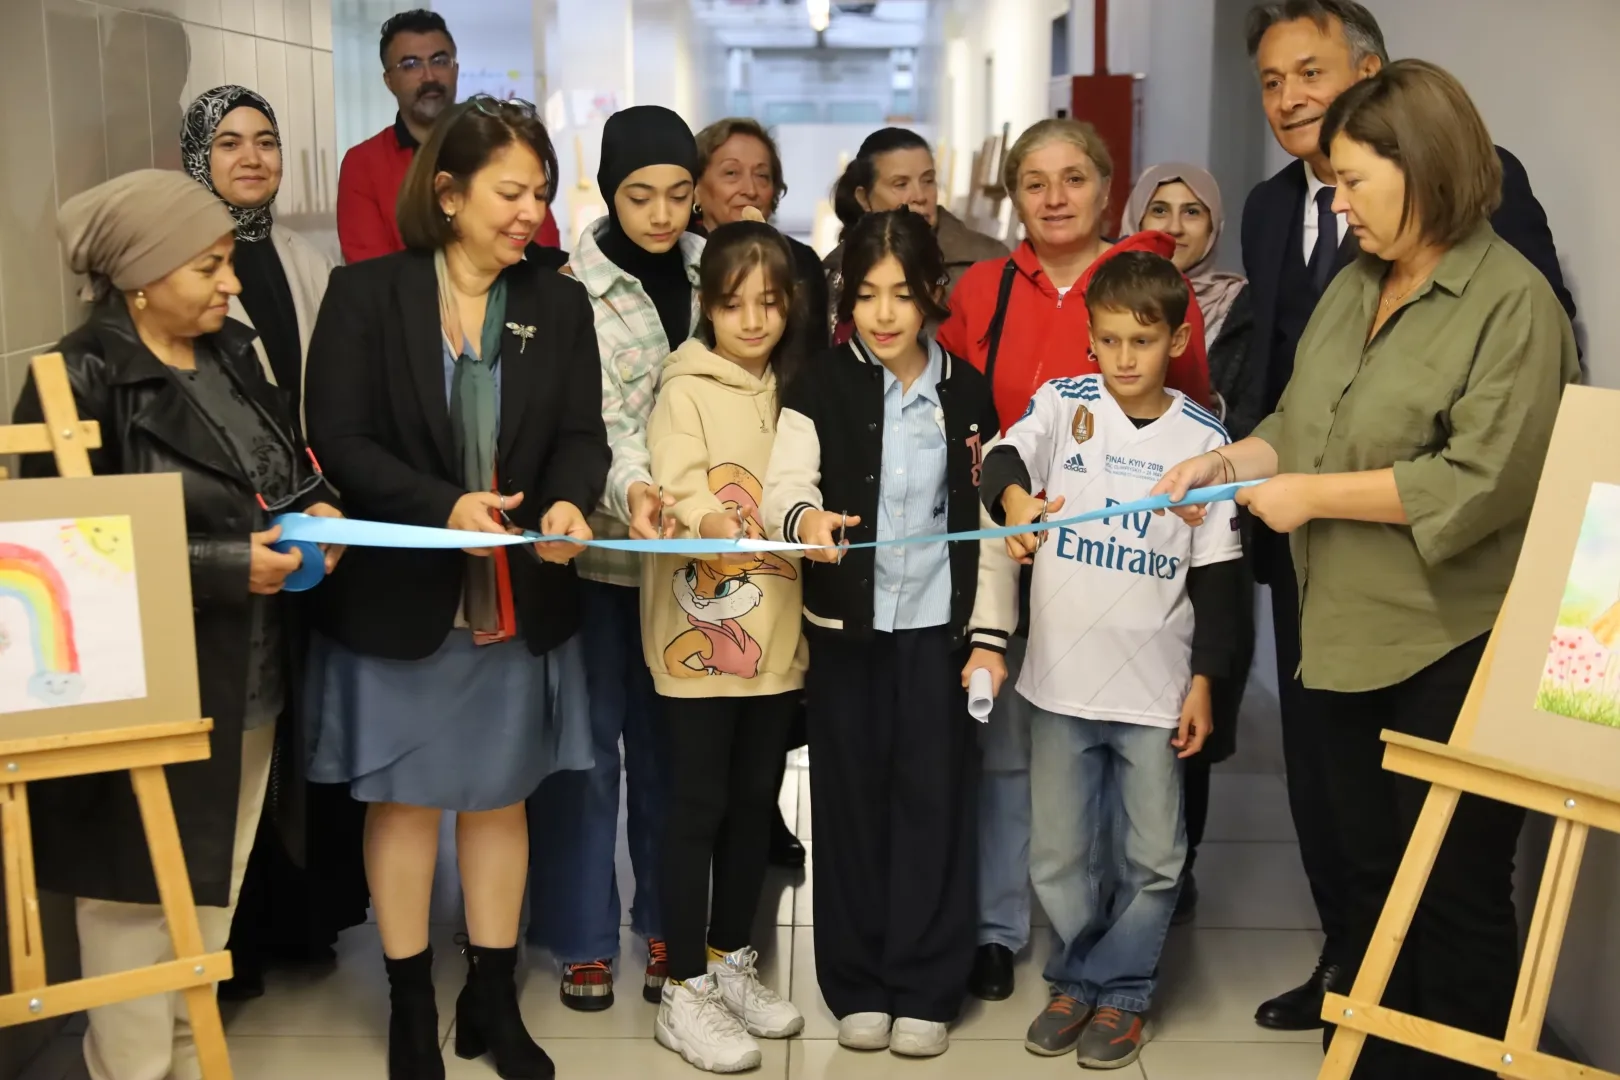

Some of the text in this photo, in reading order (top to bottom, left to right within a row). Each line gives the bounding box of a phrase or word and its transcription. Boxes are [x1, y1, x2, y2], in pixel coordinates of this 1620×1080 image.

[1063, 463, 1087, 474] adidas
[1106, 455, 1163, 472] FINAL KYIV 2018
[1102, 497, 1152, 538] Fly
[1056, 526, 1180, 580] Emirates
